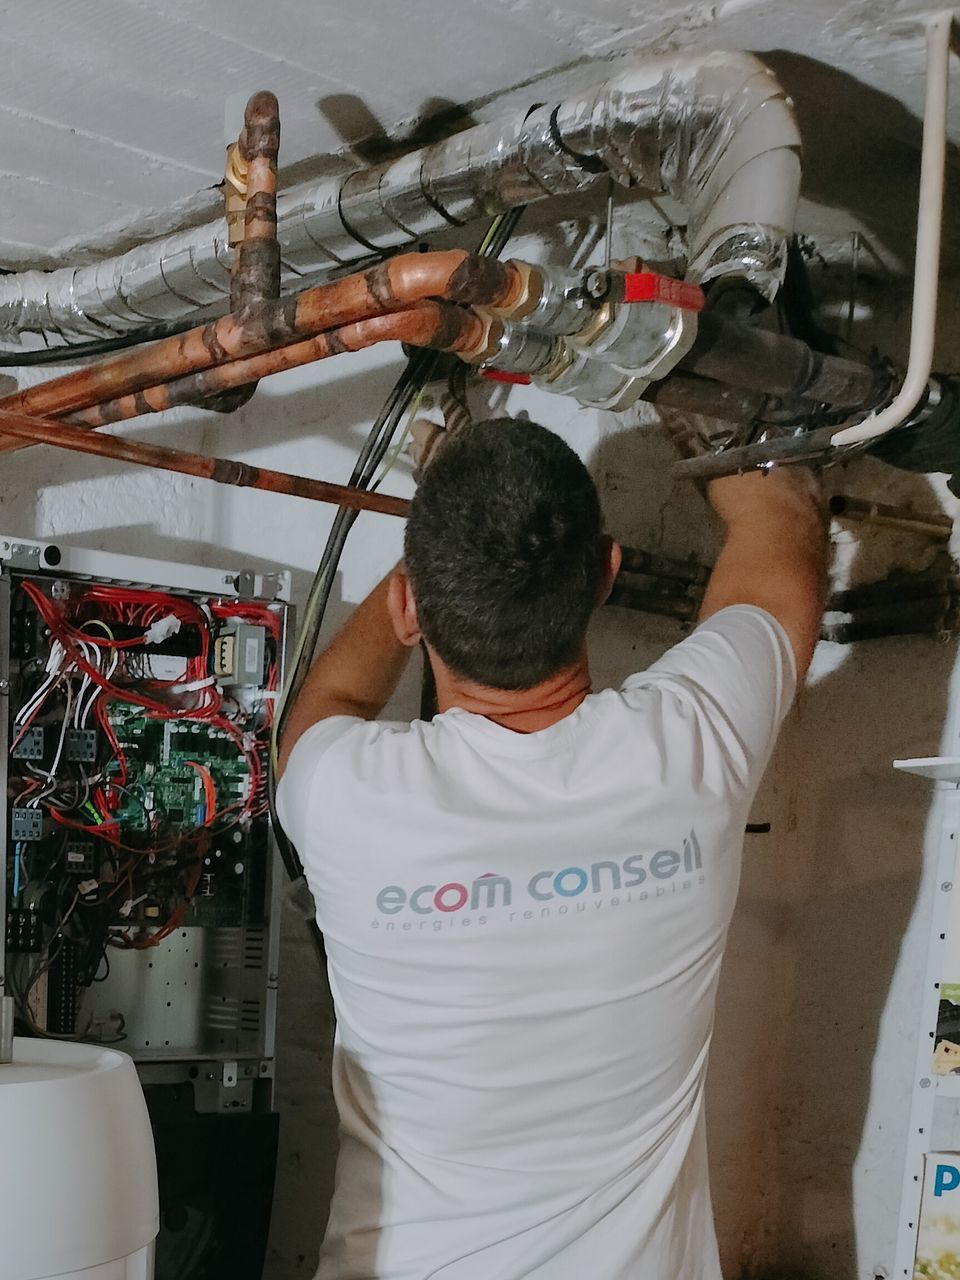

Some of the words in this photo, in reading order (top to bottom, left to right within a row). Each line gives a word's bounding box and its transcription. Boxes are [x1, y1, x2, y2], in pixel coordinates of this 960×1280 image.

[376, 873, 512, 915] ecom
[527, 826, 703, 901] conseil
[509, 875, 705, 922] renouvelables
